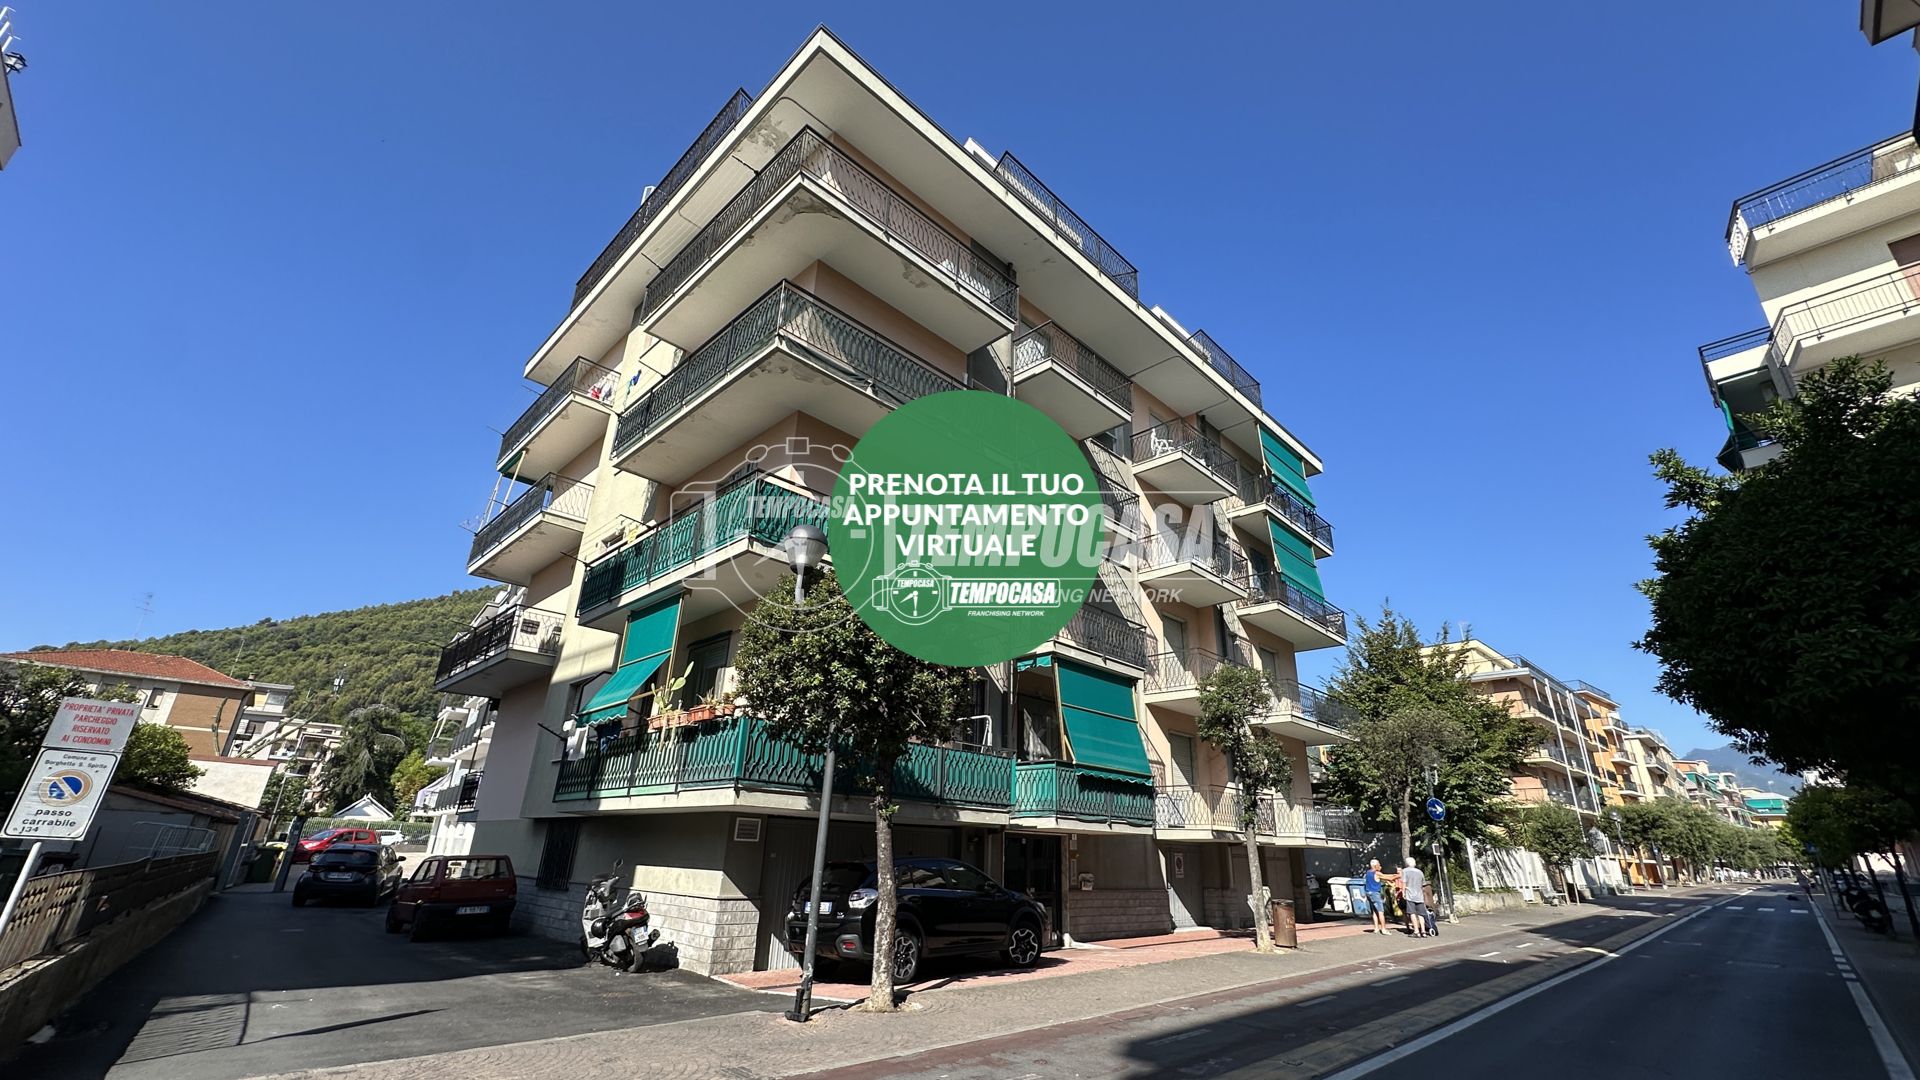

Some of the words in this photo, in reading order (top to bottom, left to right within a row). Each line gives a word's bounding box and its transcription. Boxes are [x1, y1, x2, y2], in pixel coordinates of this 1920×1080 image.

[106, 706, 135, 717] PRIVATA
[73, 713, 118, 726] PARCHEGGIO
[71, 724, 111, 735] RISERVATO
[61, 734, 70, 743] AI
[72, 735, 112, 746] CONDOMINI
[22, 818, 77, 827] carrabile
